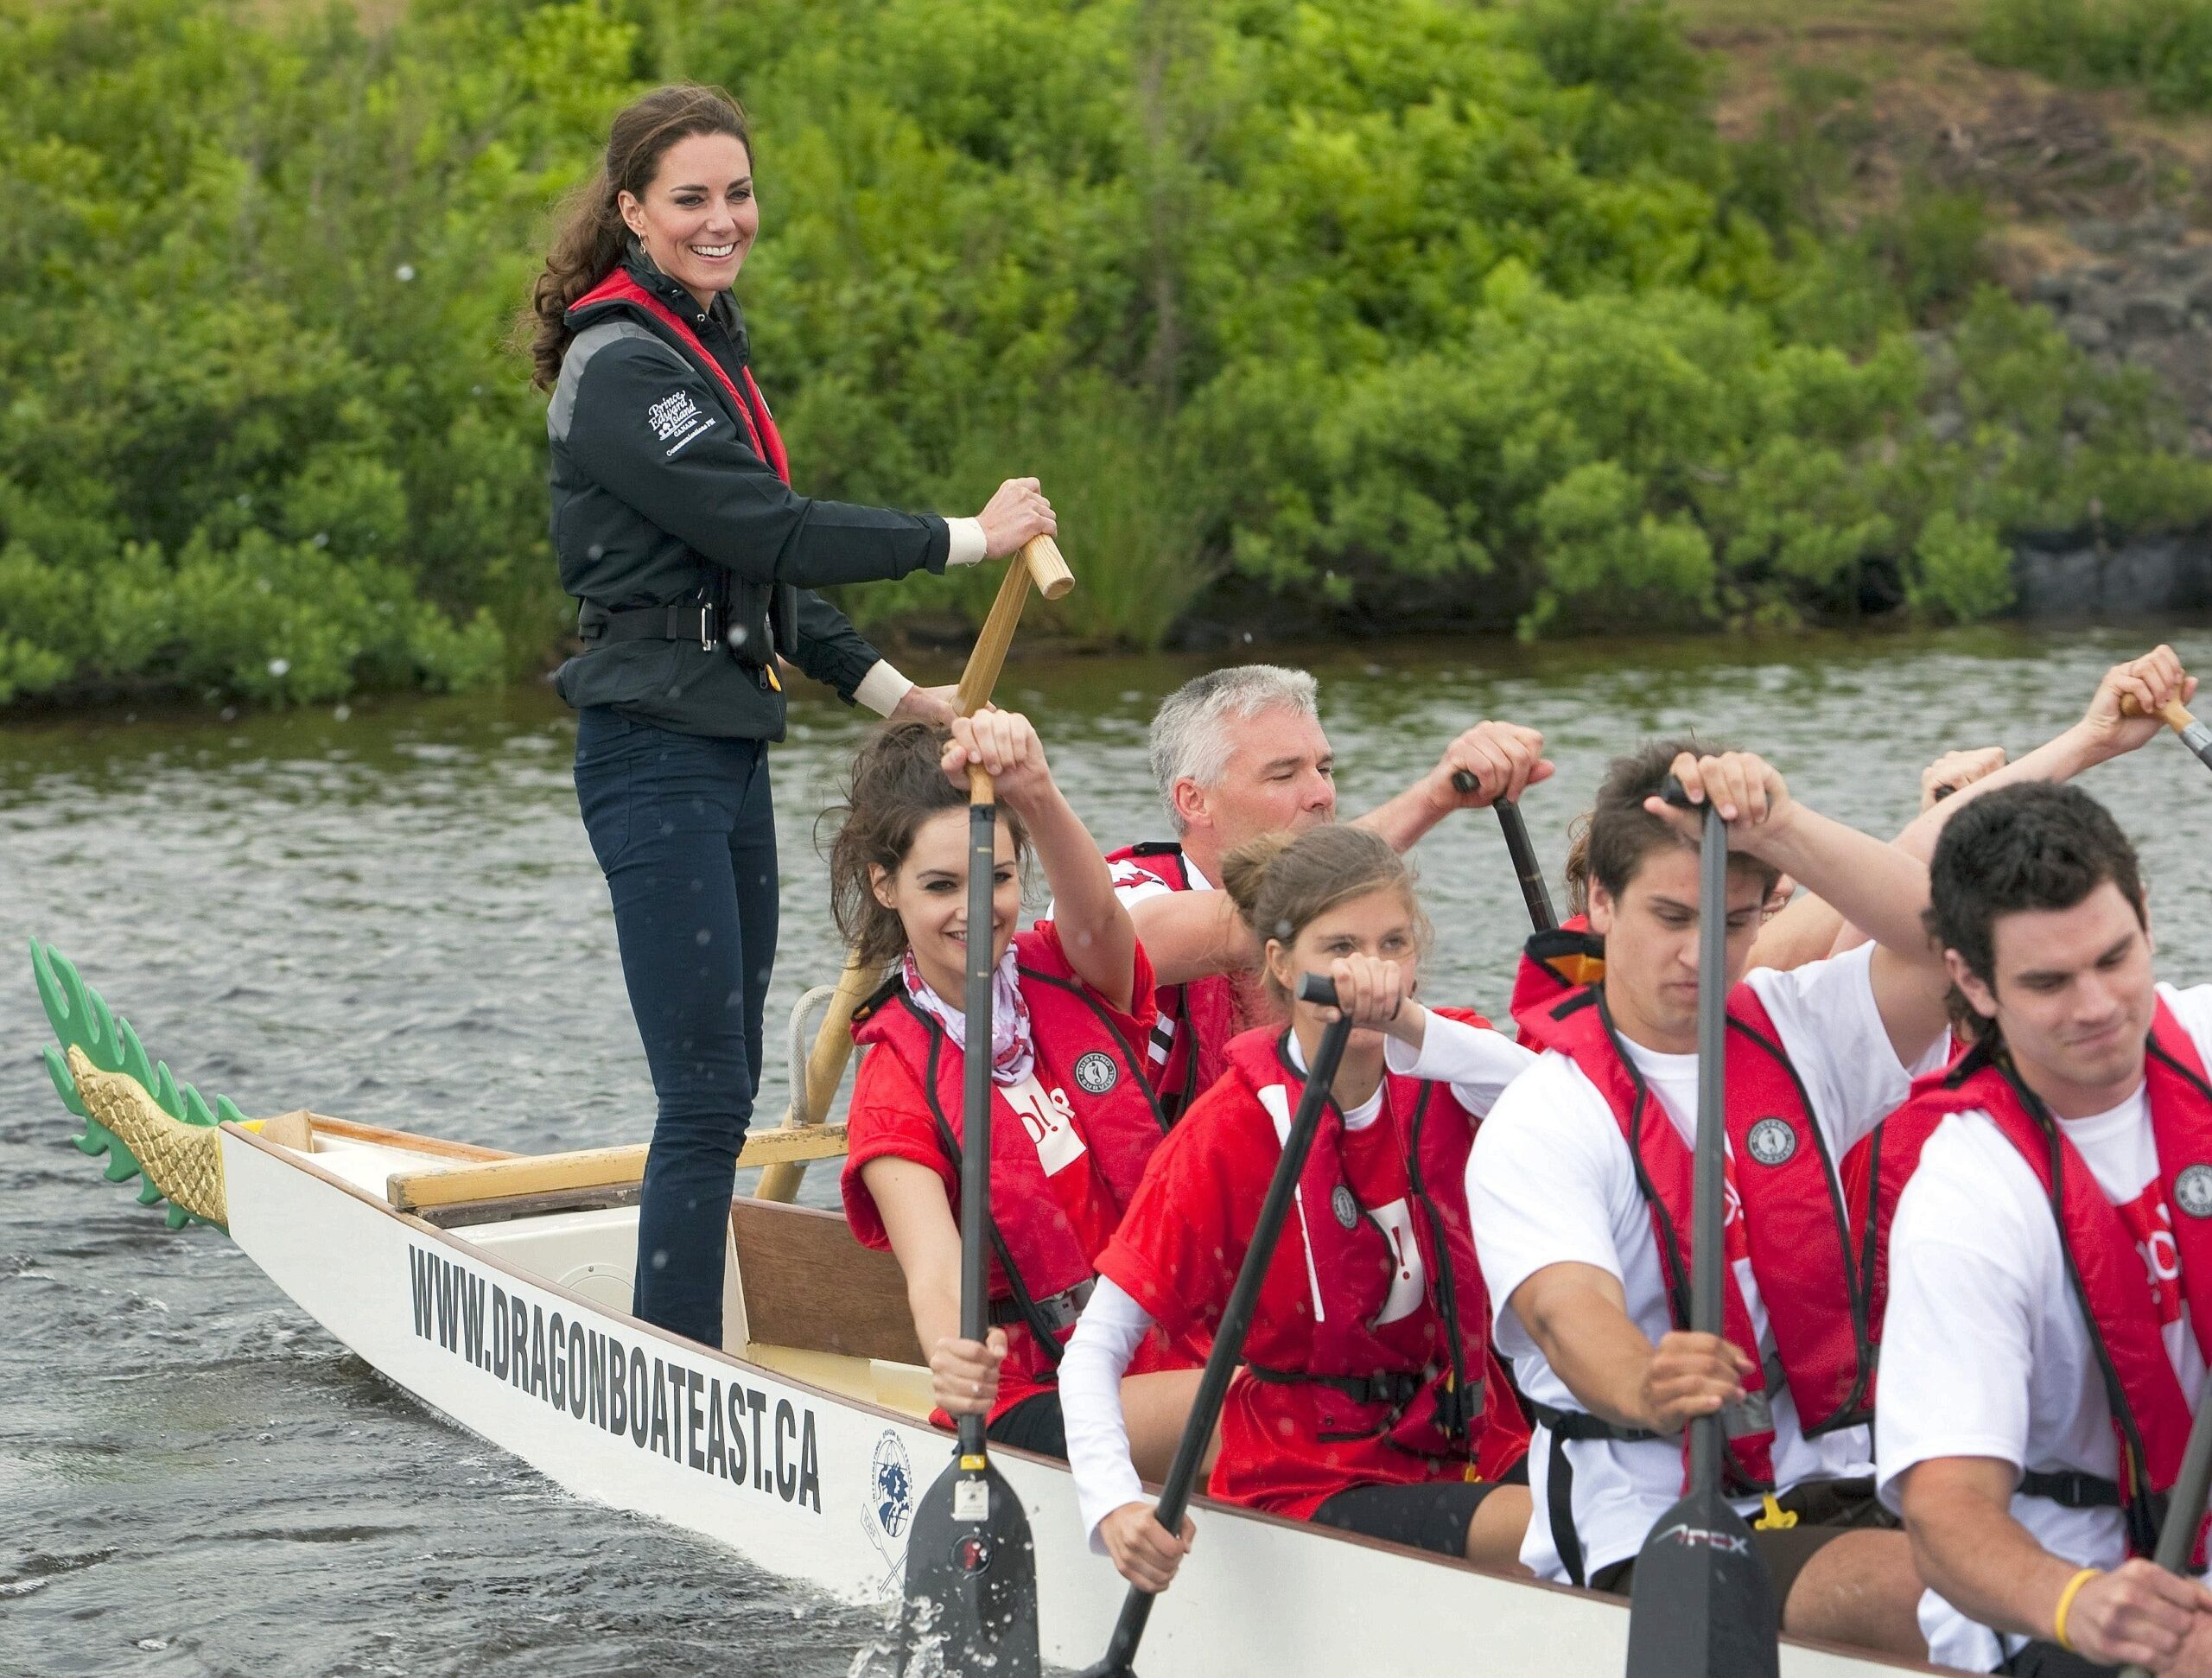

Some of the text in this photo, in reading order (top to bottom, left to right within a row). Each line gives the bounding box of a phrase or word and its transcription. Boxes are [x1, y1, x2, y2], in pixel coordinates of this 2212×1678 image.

[648, 391, 685, 417] Prince
[648, 399, 687, 431] Edward
[670, 398, 696, 427] Island
[673, 418, 697, 437] CANADA
[1079, 1054, 1110, 1075] MUSTANG
[1081, 1071, 1115, 1090] SURVIVAL
[410, 1244, 821, 1514] WWW.DRAGONBOATEAST.CA
